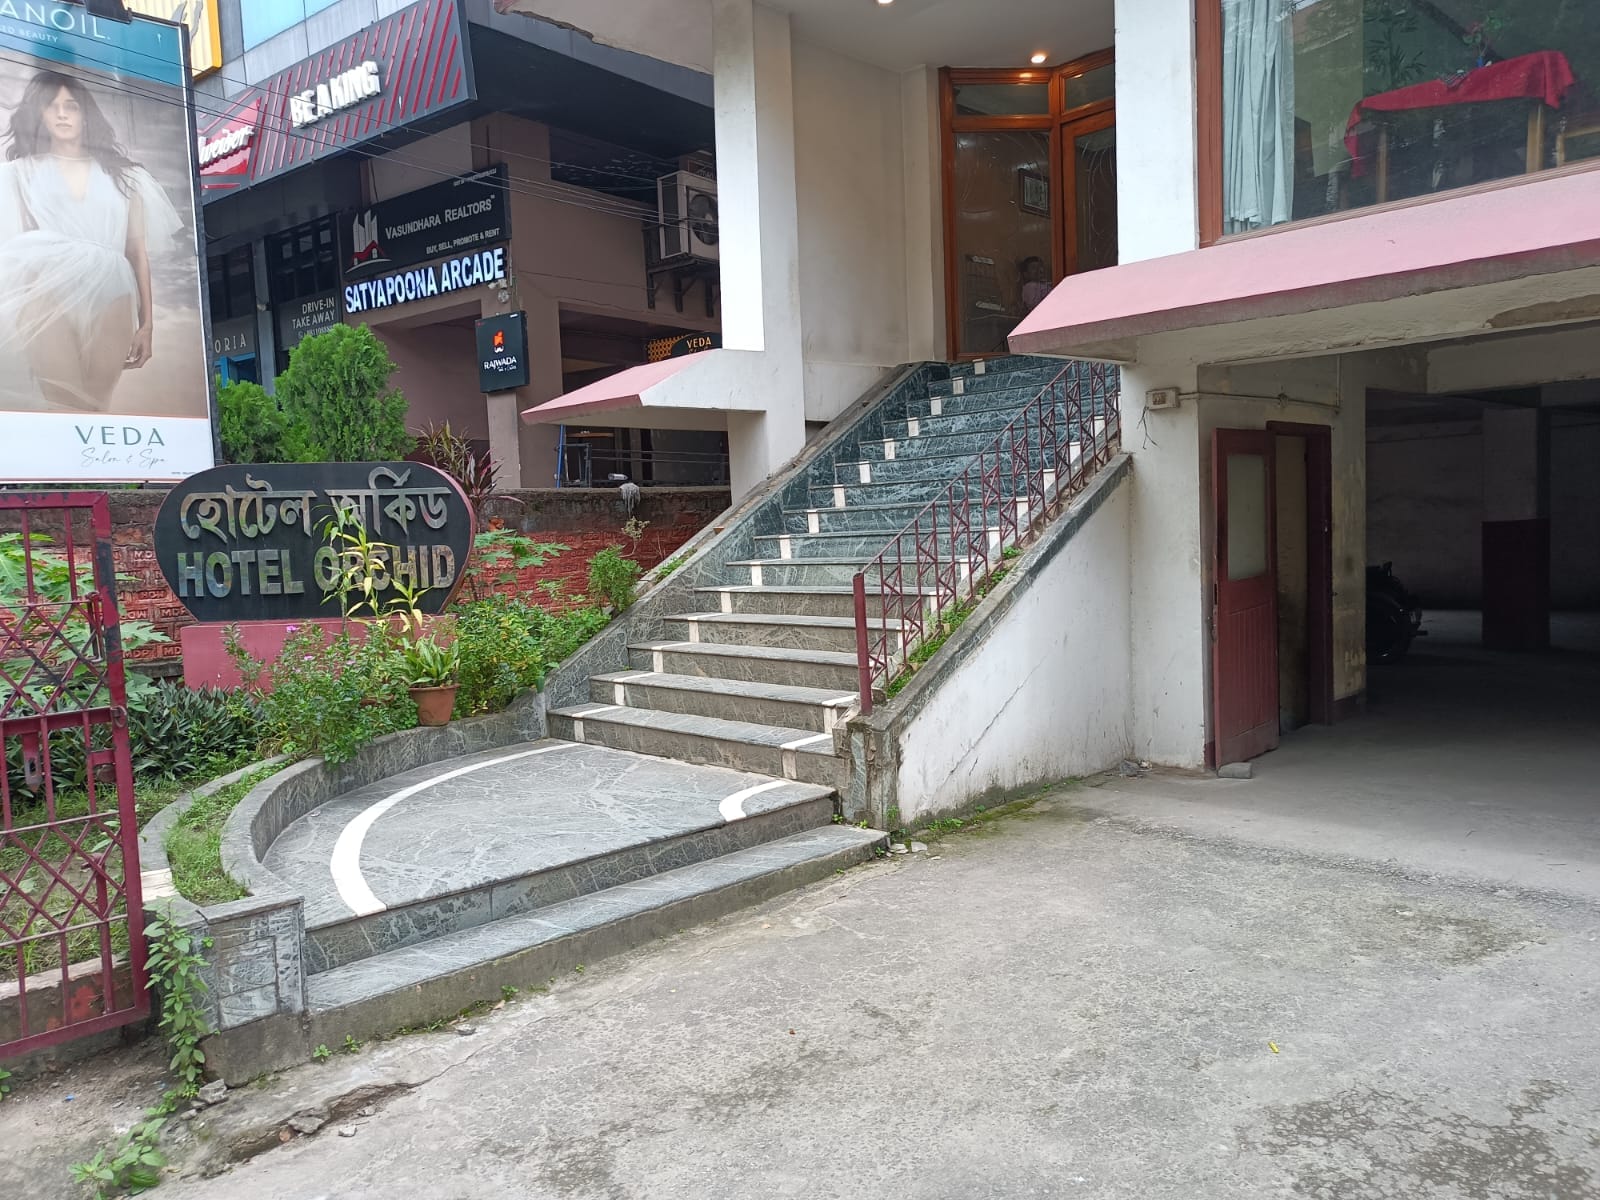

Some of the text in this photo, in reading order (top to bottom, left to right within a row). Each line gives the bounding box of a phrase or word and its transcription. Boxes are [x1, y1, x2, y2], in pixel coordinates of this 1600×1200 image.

[19, 28, 58, 43] BEAUTY
[385, 214, 442, 239] VASUNDHARA
[453, 234, 479, 247] PROMOTE
[485, 228, 500, 238] RENT
[345, 248, 505, 313] SATYAPOONA ARCADE
[302, 297, 335, 315] DRIVE-IN
[292, 310, 335, 329] TAKE AWAY
[686, 336, 712, 349] VEDA
[75, 425, 165, 447] VEDA
[80, 447, 121, 468] Salon
[139, 448, 168, 469] Spa
[180, 473, 318, 544] হোটেল
[177, 549, 305, 598] HOTEL
